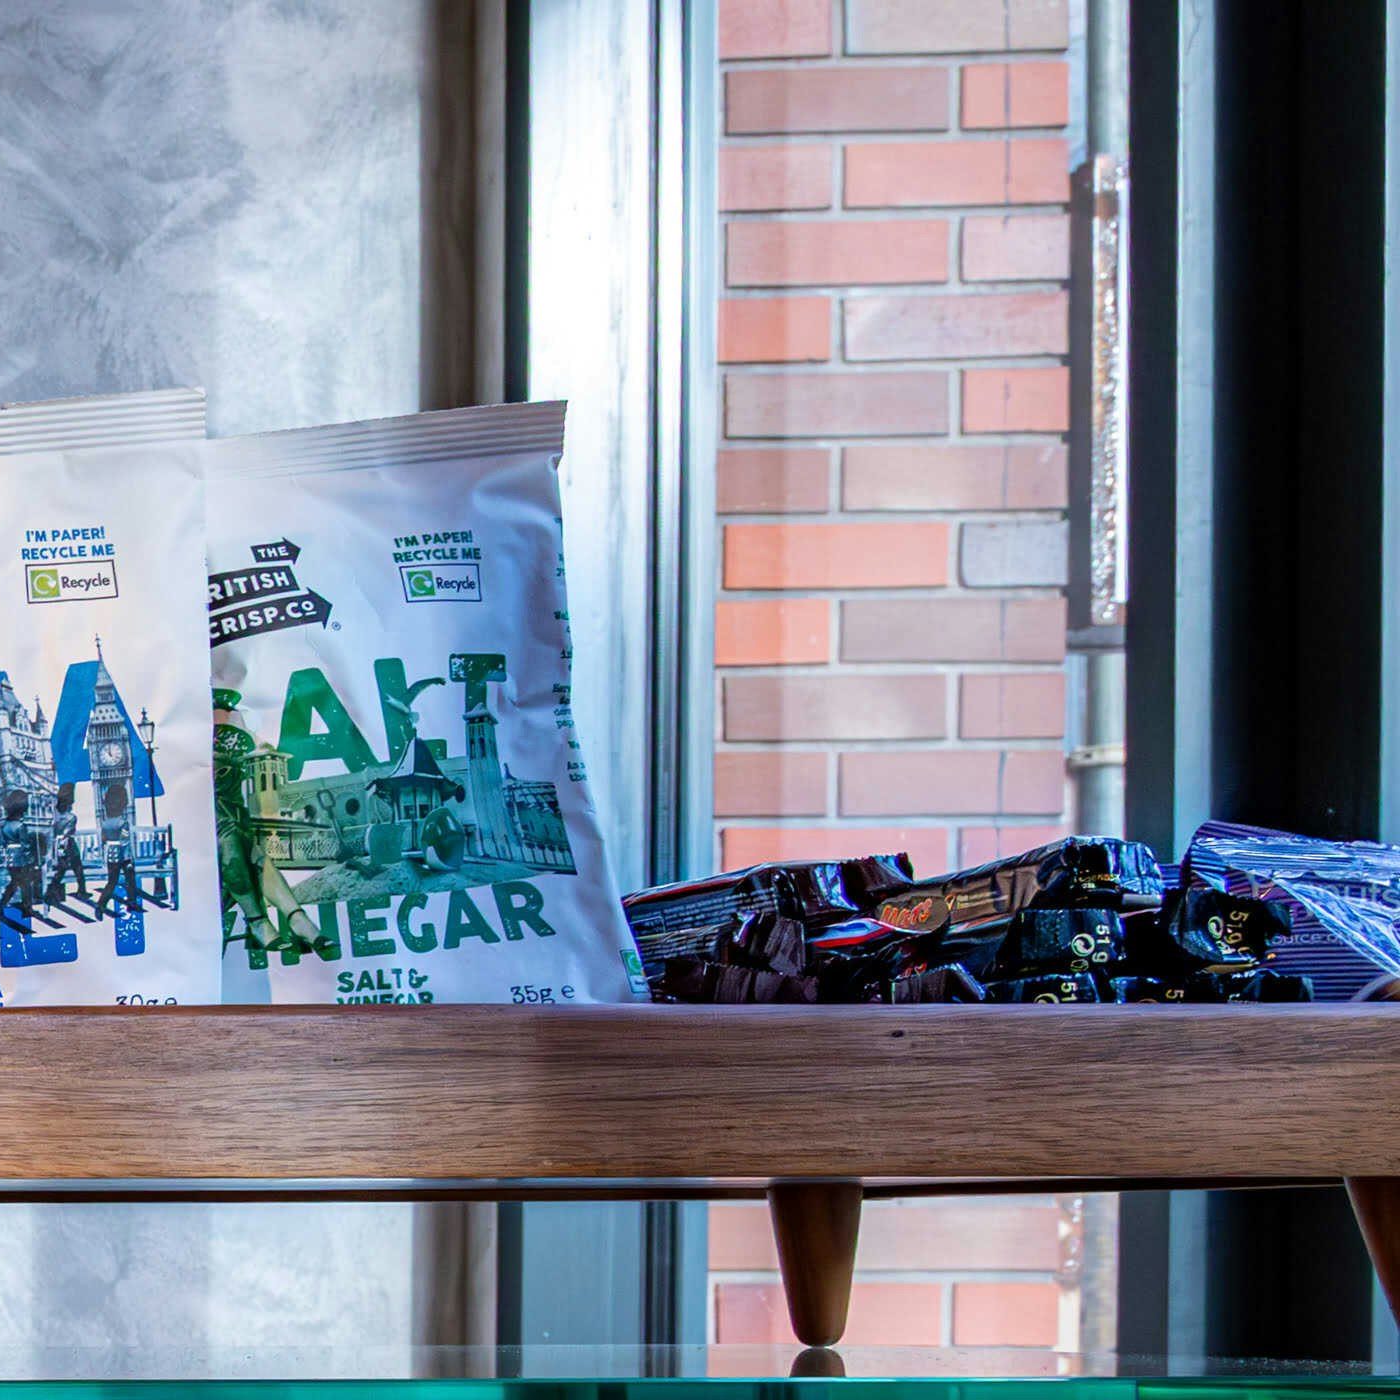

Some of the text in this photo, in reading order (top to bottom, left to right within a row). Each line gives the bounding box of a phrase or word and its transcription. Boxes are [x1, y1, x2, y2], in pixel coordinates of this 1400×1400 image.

[25, 526, 105, 543] I'M PAPER!
[394, 530, 473, 548] I'M PAPER!
[21, 543, 115, 560] RECYCLE ME
[257, 545, 289, 559] THE
[392, 547, 482, 563] RECYCLE ME
[61, 572, 110, 592] Recycle
[208, 571, 290, 604] RITISH
[436, 576, 476, 592] Recycle
[222, 880, 557, 970] NEGAR
[1095, 924, 1111, 944] 51
[337, 968, 429, 993] SALT &
